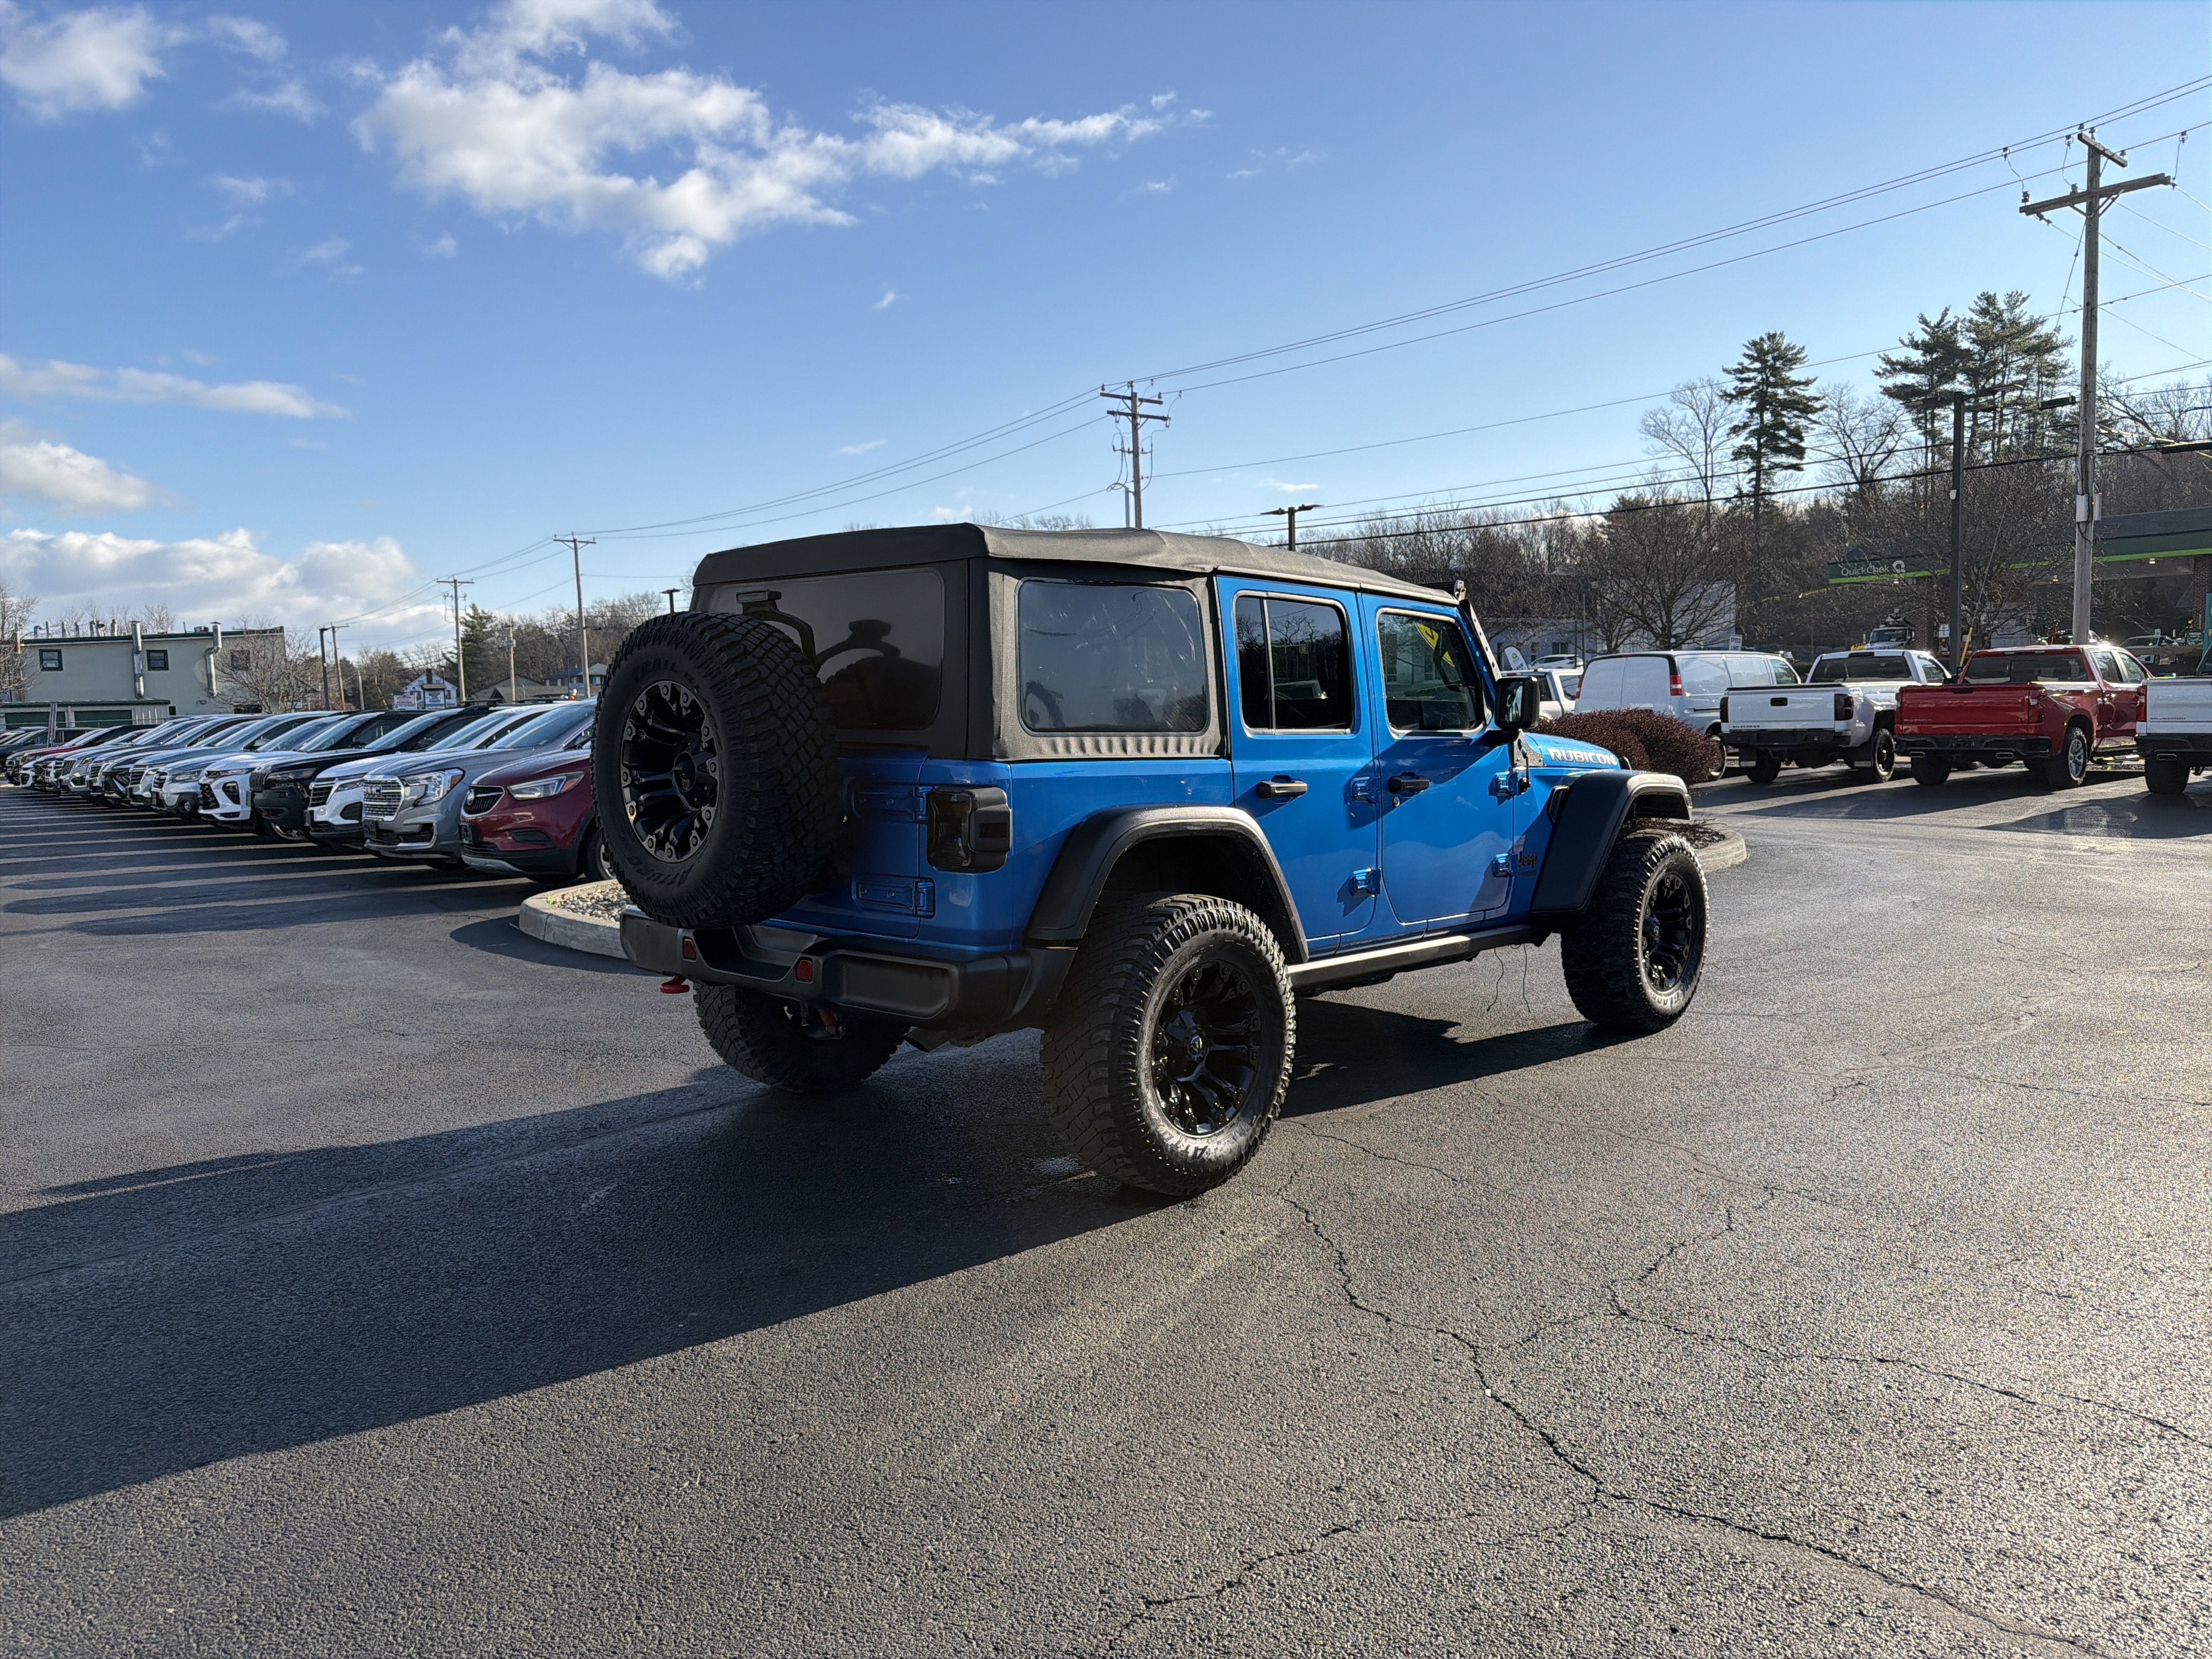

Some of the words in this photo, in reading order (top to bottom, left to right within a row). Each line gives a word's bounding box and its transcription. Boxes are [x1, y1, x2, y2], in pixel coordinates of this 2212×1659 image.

[1841, 564, 1889, 577] QuickChek
[1547, 748, 1618, 766] RUBICON
[1518, 851, 1538, 868] Jeep
